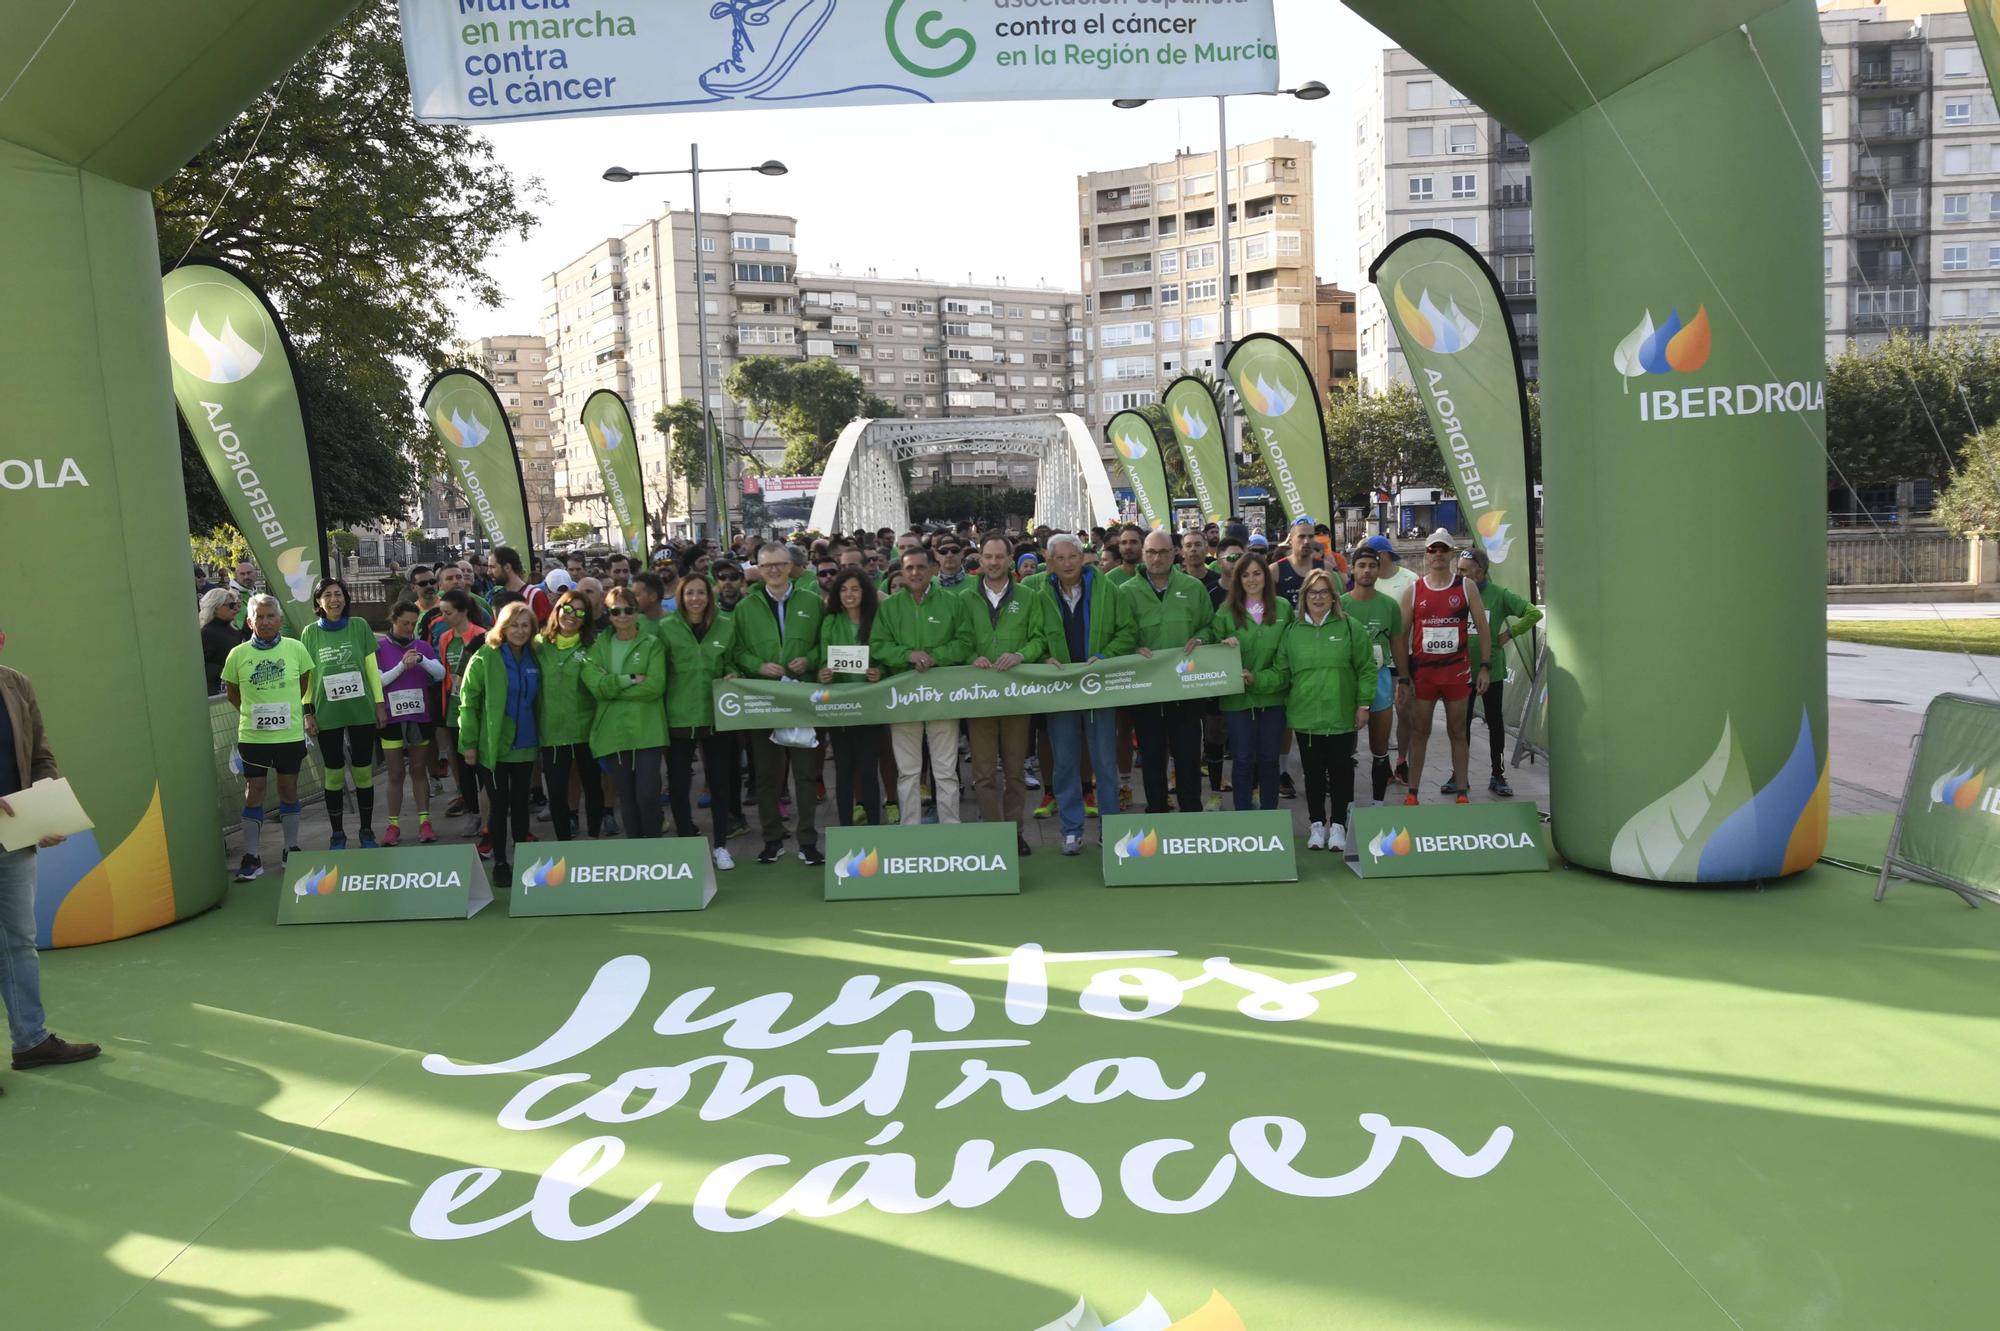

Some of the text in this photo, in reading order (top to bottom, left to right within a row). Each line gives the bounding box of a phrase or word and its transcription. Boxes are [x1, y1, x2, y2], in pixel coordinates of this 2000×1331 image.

[461, 10, 636, 45] en marcha
[995, 12, 1197, 37] contra el cáncer
[465, 44, 568, 76] contra
[996, 38, 1278, 70] en la Región de Murcia
[468, 74, 616, 107] el cáncer
[1640, 380, 1826, 421] IBERDROLA
[1427, 640, 1454, 649] 0088
[834, 659, 863, 669] 2010
[1181, 670, 1227, 682] IBERDROLA
[331, 684, 359, 696] 1292
[886, 679, 1073, 709] Juntos contra el cáncer
[395, 700, 422, 711] 0962
[815, 702, 862, 712] IBERDROLA
[257, 715, 286, 726] 2203
[1162, 835, 1285, 855] IBERDROLA
[1415, 832, 1536, 853] IBERDROLA
[569, 863, 694, 884] IBERDROLA
[883, 854, 1007, 875] IBERDROLA
[341, 870, 461, 893] IBERDROLA
[422, 944, 1356, 1074] Juntos
[496, 1030, 1206, 1130] contra
[410, 1113, 1514, 1242] el cáncer
